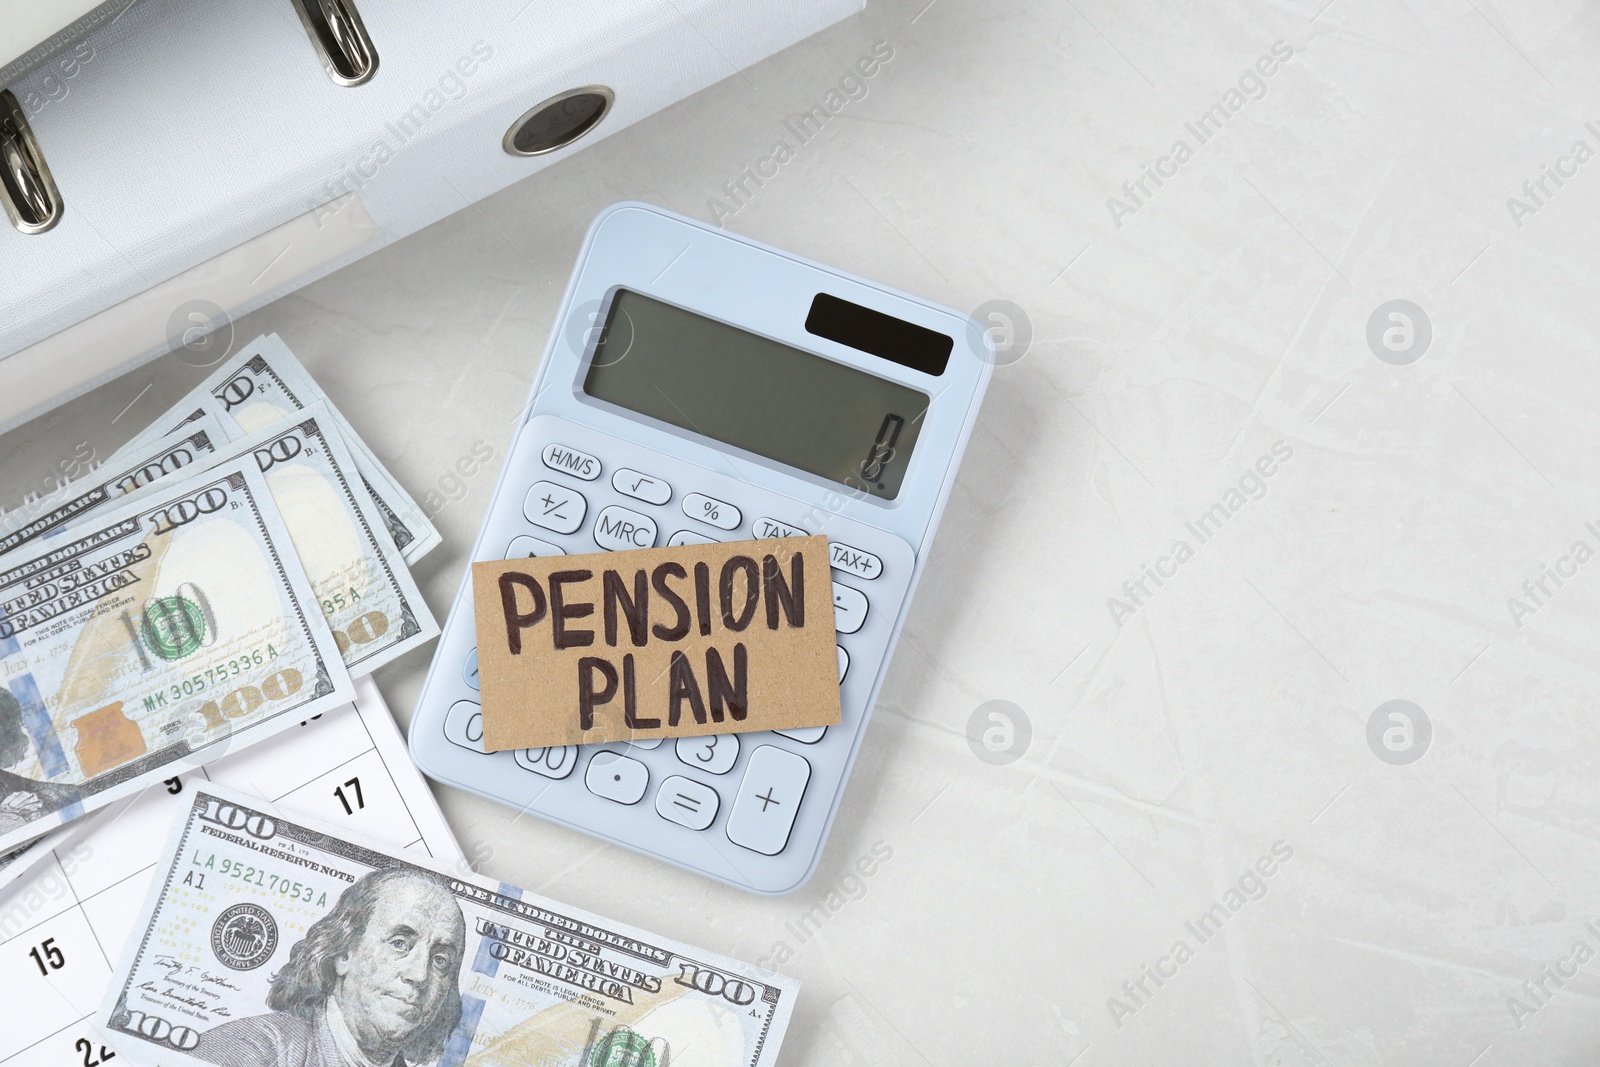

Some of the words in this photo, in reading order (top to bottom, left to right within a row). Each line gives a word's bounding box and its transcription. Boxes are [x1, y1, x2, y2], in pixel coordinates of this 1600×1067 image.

[549, 447, 594, 475] H/M/S
[148, 487, 228, 536] 100
[599, 515, 651, 548] MRC
[832, 546, 873, 572] TAX+
[24, 638, 37, 649] FOR
[37, 633, 50, 643] ALL
[73, 614, 96, 627] PUBLIC
[97, 607, 111, 618] AND
[110, 596, 136, 611] PRIVATE
[35, 626, 50, 637] THIS
[50, 620, 68, 633] NOTE
[75, 609, 95, 622] LEGAL
[95, 596, 120, 612] TENDER
[498, 551, 805, 655] PENSION
[142, 690, 169, 713] MK
[169, 649, 263, 700] 30575336
[267, 643, 279, 659] A
[578, 642, 748, 731] PLAN
[333, 777, 365, 816] 17
[198, 800, 277, 841] 100
[200, 825, 259, 852] FEDERAL
[258, 844, 320, 872] RESERVE
[318, 864, 355, 885] NOTE
[192, 849, 216, 871] LA
[219, 858, 314, 904] 95217053
[316, 891, 328, 908] A
[226, 906, 255, 919] UNITED
[255, 910, 274, 932] STATES
[28, 936, 66, 977] 15
[489, 941, 525, 967] OF
[519, 952, 634, 1006] AMERICA
[566, 948, 663, 995] STATES
[503, 974, 516, 984] FOR
[516, 978, 530, 988] ALL
[552, 989, 577, 1003] PUBLIC
[577, 998, 591, 1009] AND
[590, 1003, 618, 1017] PRIVATE
[519, 973, 534, 983] THIS
[534, 978, 551, 989] NOTE
[558, 987, 579, 999] LEGAL
[579, 992, 606, 1007] TENDER
[674, 963, 756, 1006] 100
[127, 1010, 200, 1052] 100
